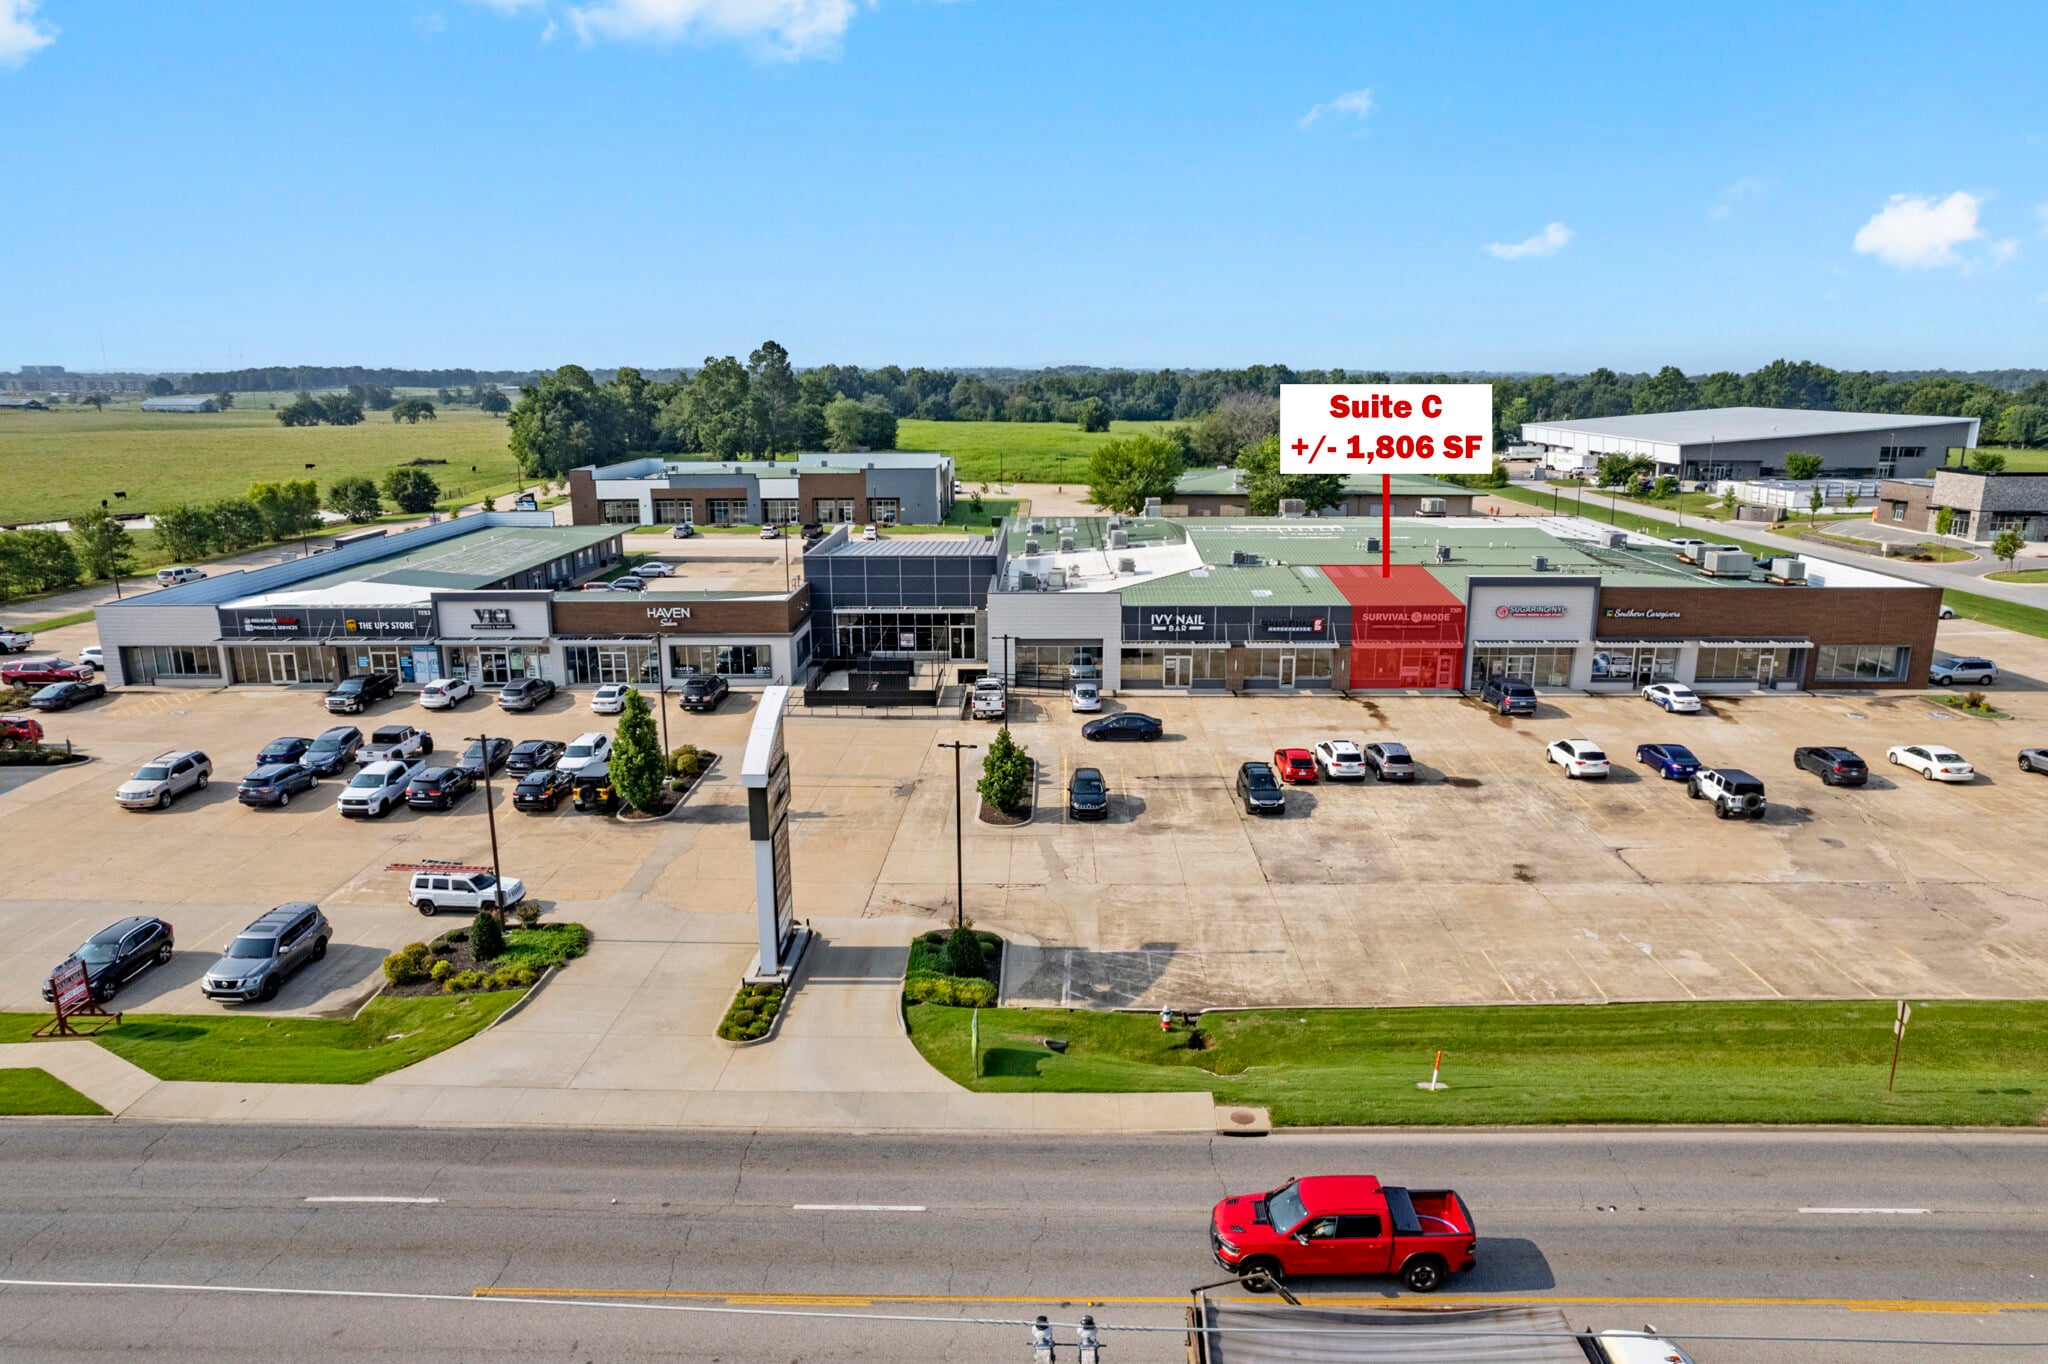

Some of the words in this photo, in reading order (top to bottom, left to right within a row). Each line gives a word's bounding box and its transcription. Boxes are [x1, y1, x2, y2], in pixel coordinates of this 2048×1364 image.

[646, 607, 691, 618] HAVEN
[1510, 605, 1548, 613] SUGARING
[1614, 608, 1645, 618] Southern
[1646, 608, 1680, 619] Caregivers
[473, 609, 511, 623] VICI
[1151, 614, 1173, 625] IVY
[1175, 614, 1206, 625] NAIL
[1362, 613, 1410, 621] SURVIVAL
[1422, 613, 1450, 621] MODE
[359, 621, 373, 630] THE
[374, 621, 390, 630] UPS
[391, 621, 415, 630] STORE
